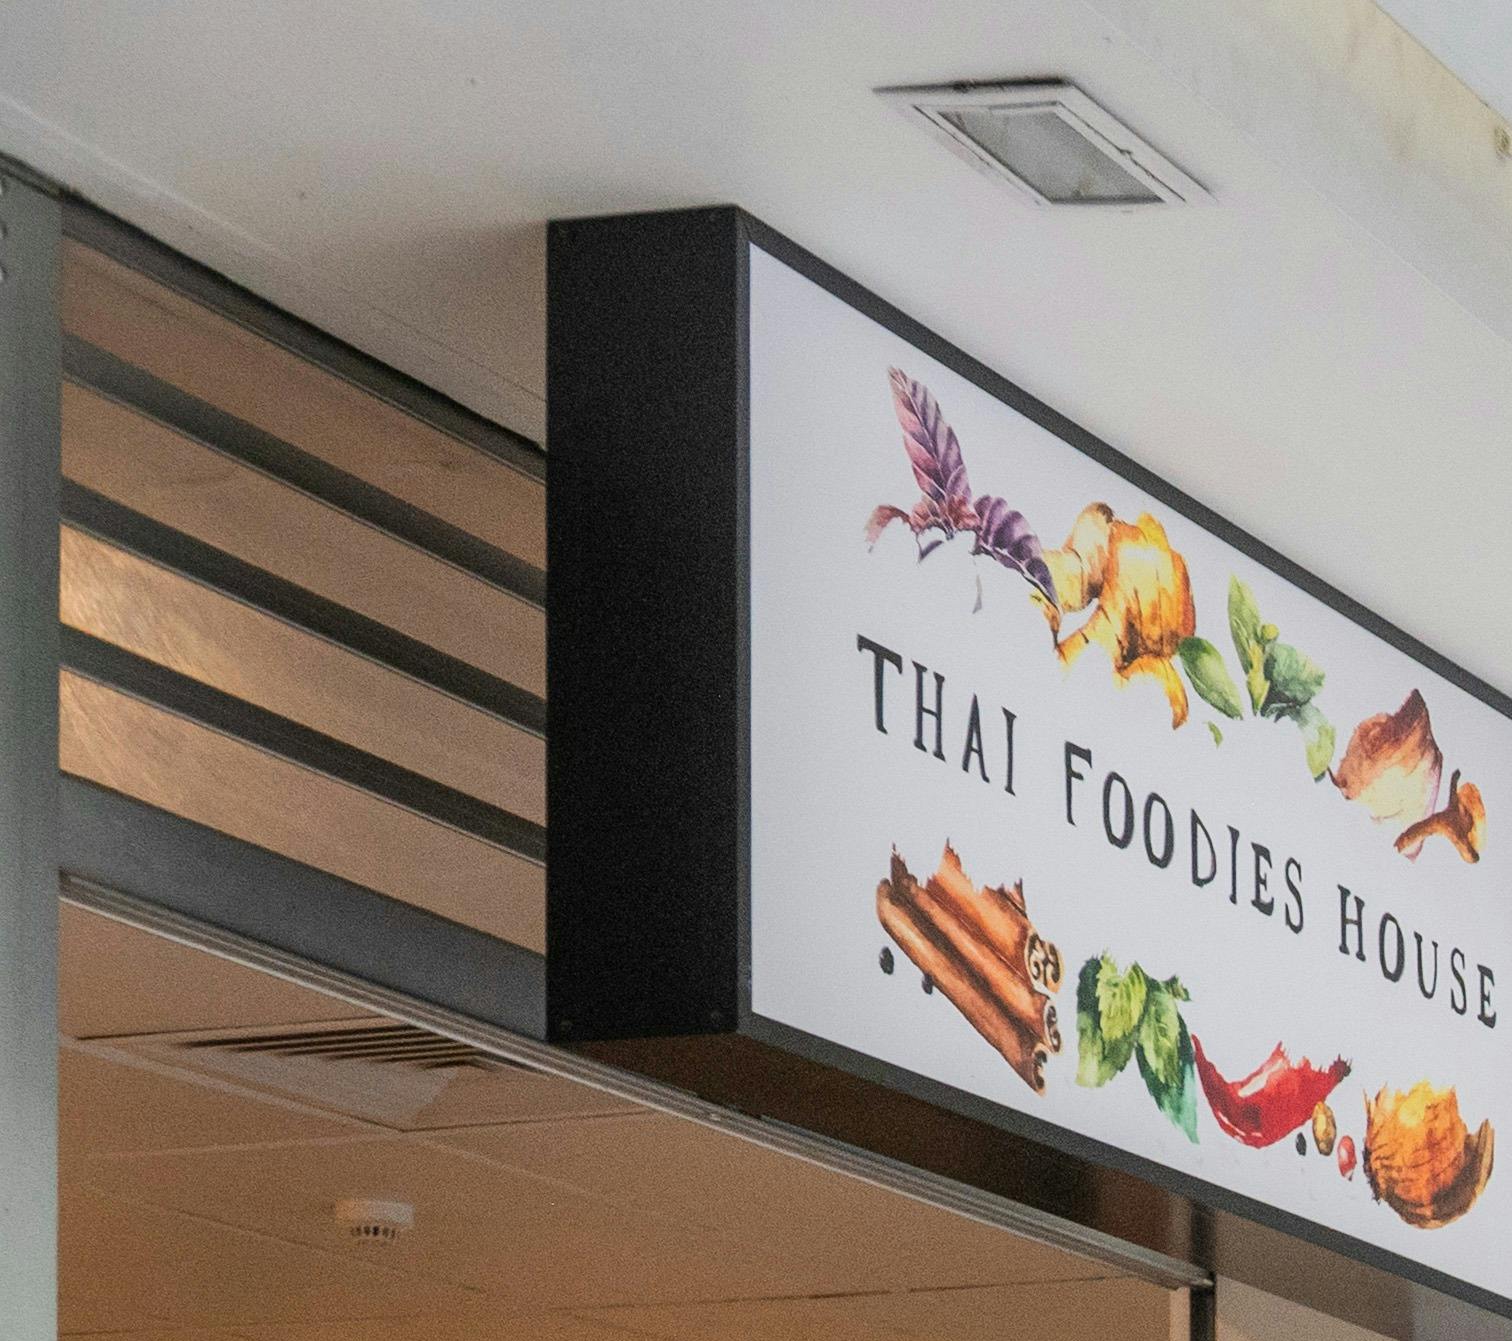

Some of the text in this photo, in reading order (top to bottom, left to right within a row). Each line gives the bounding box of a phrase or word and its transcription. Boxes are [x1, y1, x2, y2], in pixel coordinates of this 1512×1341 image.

[857, 635, 1497, 1028] THAI FOODIES HOUSE
